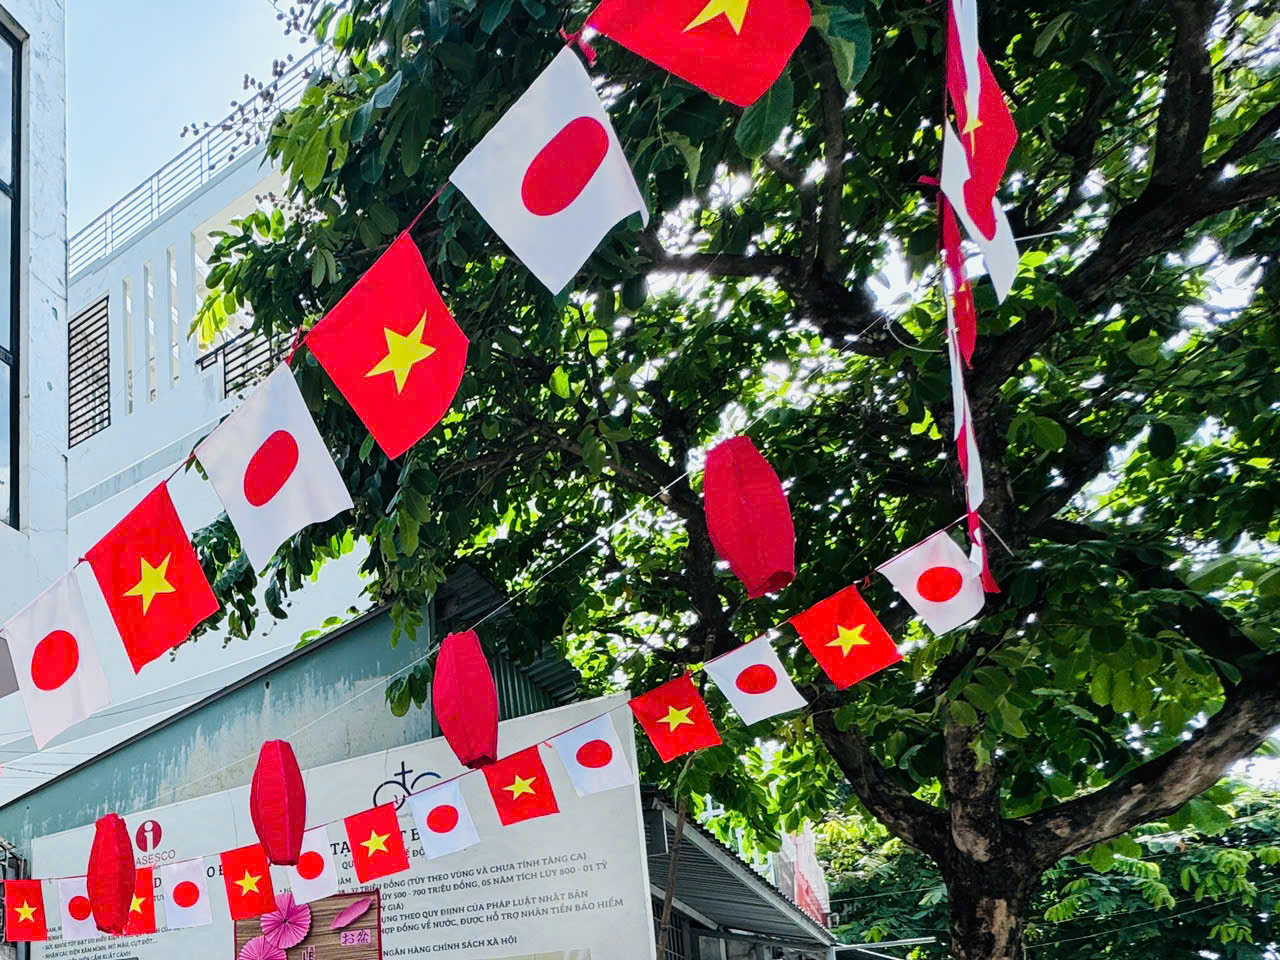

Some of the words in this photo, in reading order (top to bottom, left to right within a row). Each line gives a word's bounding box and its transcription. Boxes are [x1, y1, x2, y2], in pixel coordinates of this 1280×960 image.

[136, 849, 176, 866] ASESCO
[428, 874, 448, 884] THEO
[451, 868, 474, 879] VÙNG
[476, 865, 488, 875] VÀ
[518, 858, 539, 869] TÍNH
[394, 890, 406, 898] 500
[413, 889, 425, 897] 700
[482, 879, 491, 887] 05
[516, 870, 538, 881] TÍCH
[400, 912, 420, 922] THEO
[422, 910, 438, 920] QUY
[486, 900, 510, 911] PHÁP
[384, 945, 405, 957] NGÂN
[407, 943, 431, 954] HÀNG
[433, 940, 460, 951] CHÍNH
[461, 937, 485, 949] SÁCH
